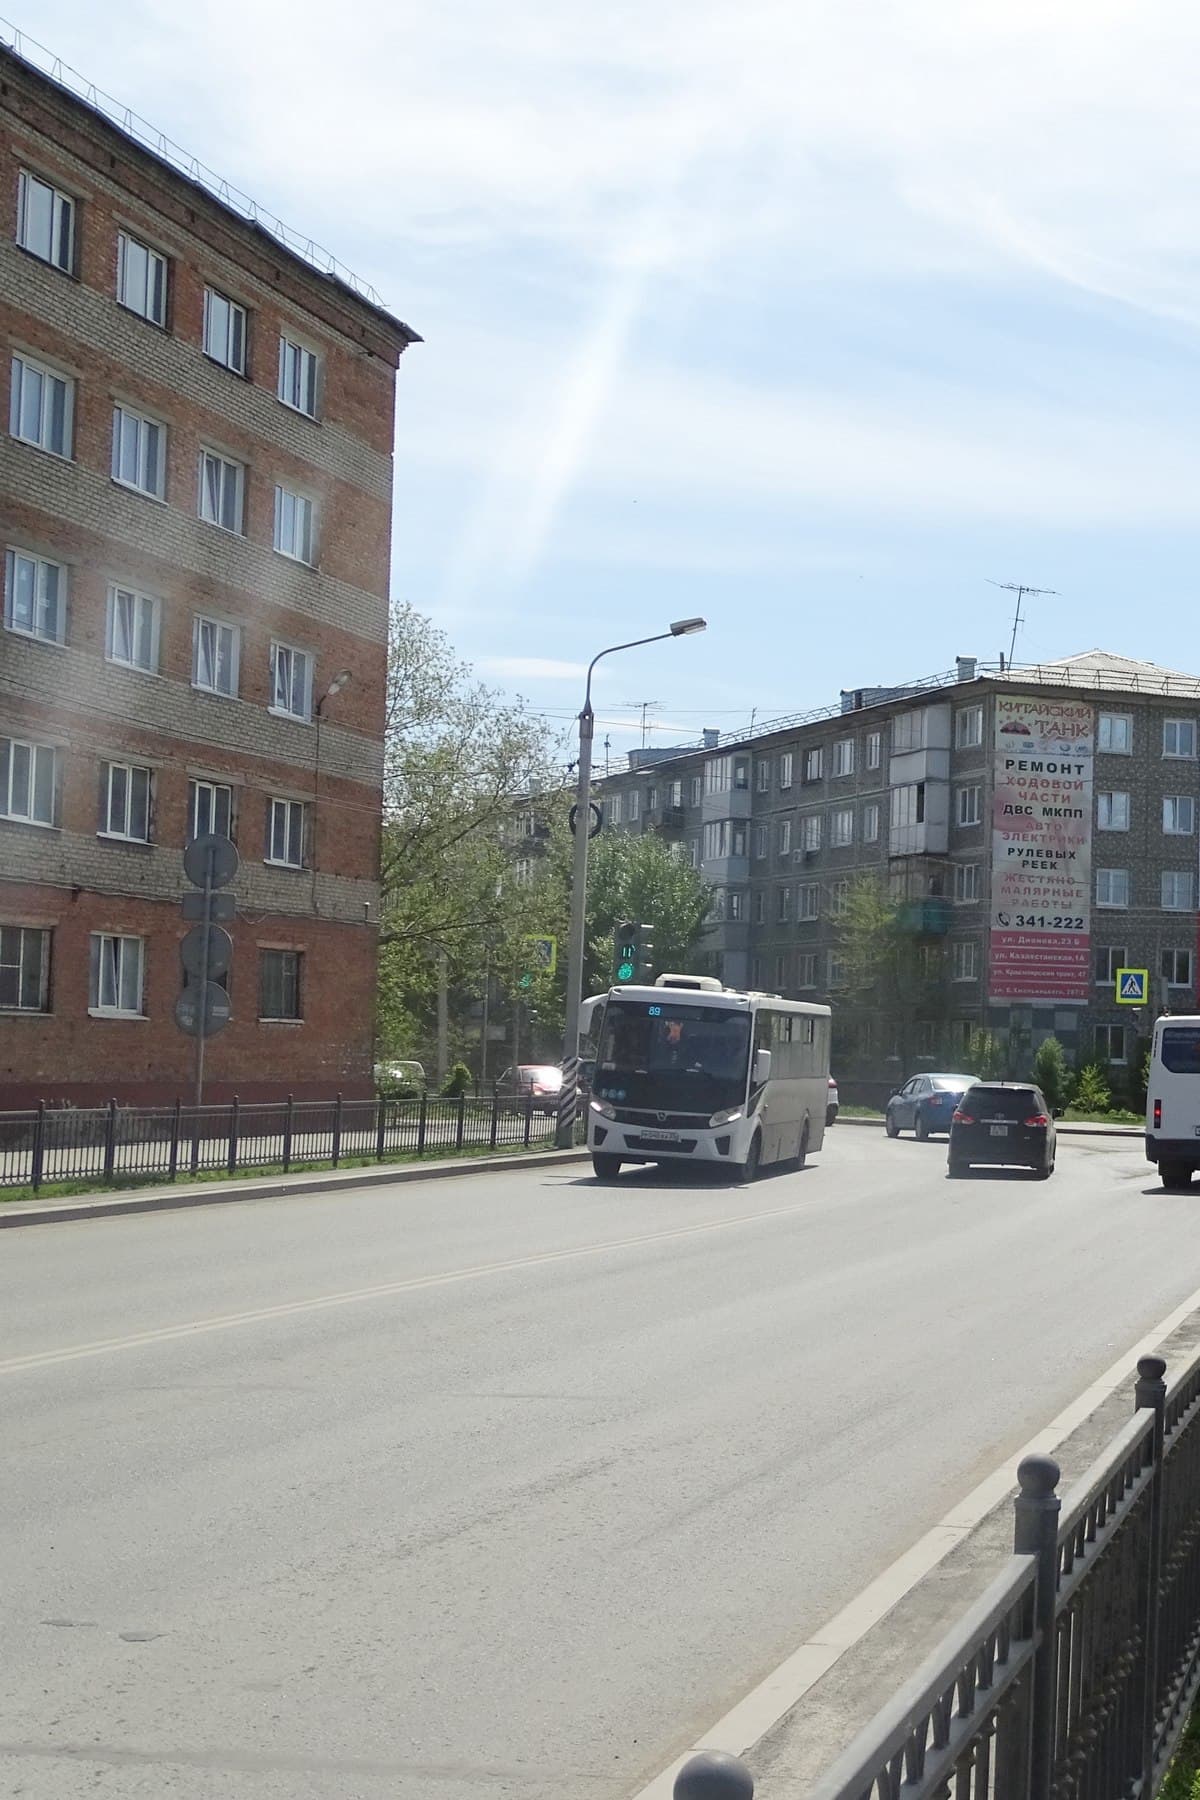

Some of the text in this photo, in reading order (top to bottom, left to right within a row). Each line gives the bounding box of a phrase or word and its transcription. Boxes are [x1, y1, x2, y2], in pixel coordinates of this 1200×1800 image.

[999, 701, 1091, 719] КИТАЙСКИЙ
[1035, 720, 1089, 738] ТАНК
[1005, 759, 1085, 775] РЕМОНТ
[1006, 777, 1084, 791] ХОДОВОЙ
[1018, 791, 1071, 804] ЧАСТИ
[1003, 804, 1083, 819] ДВС МКПП
[1026, 821, 1063, 831] АВТО
[1002, 832, 1085, 845] ЭЛЕКТРИКИ
[1007, 847, 1077, 860] РУЛЕВЫХ
[1022, 860, 1058, 870] РЕЕК
[1001, 886, 1084, 898] МАЛЯРНЫЕ
[1012, 898, 1073, 909] РАБОТЫ
[1015, 915, 1085, 929] 341-222
[648, 1006, 661, 1016] 89
